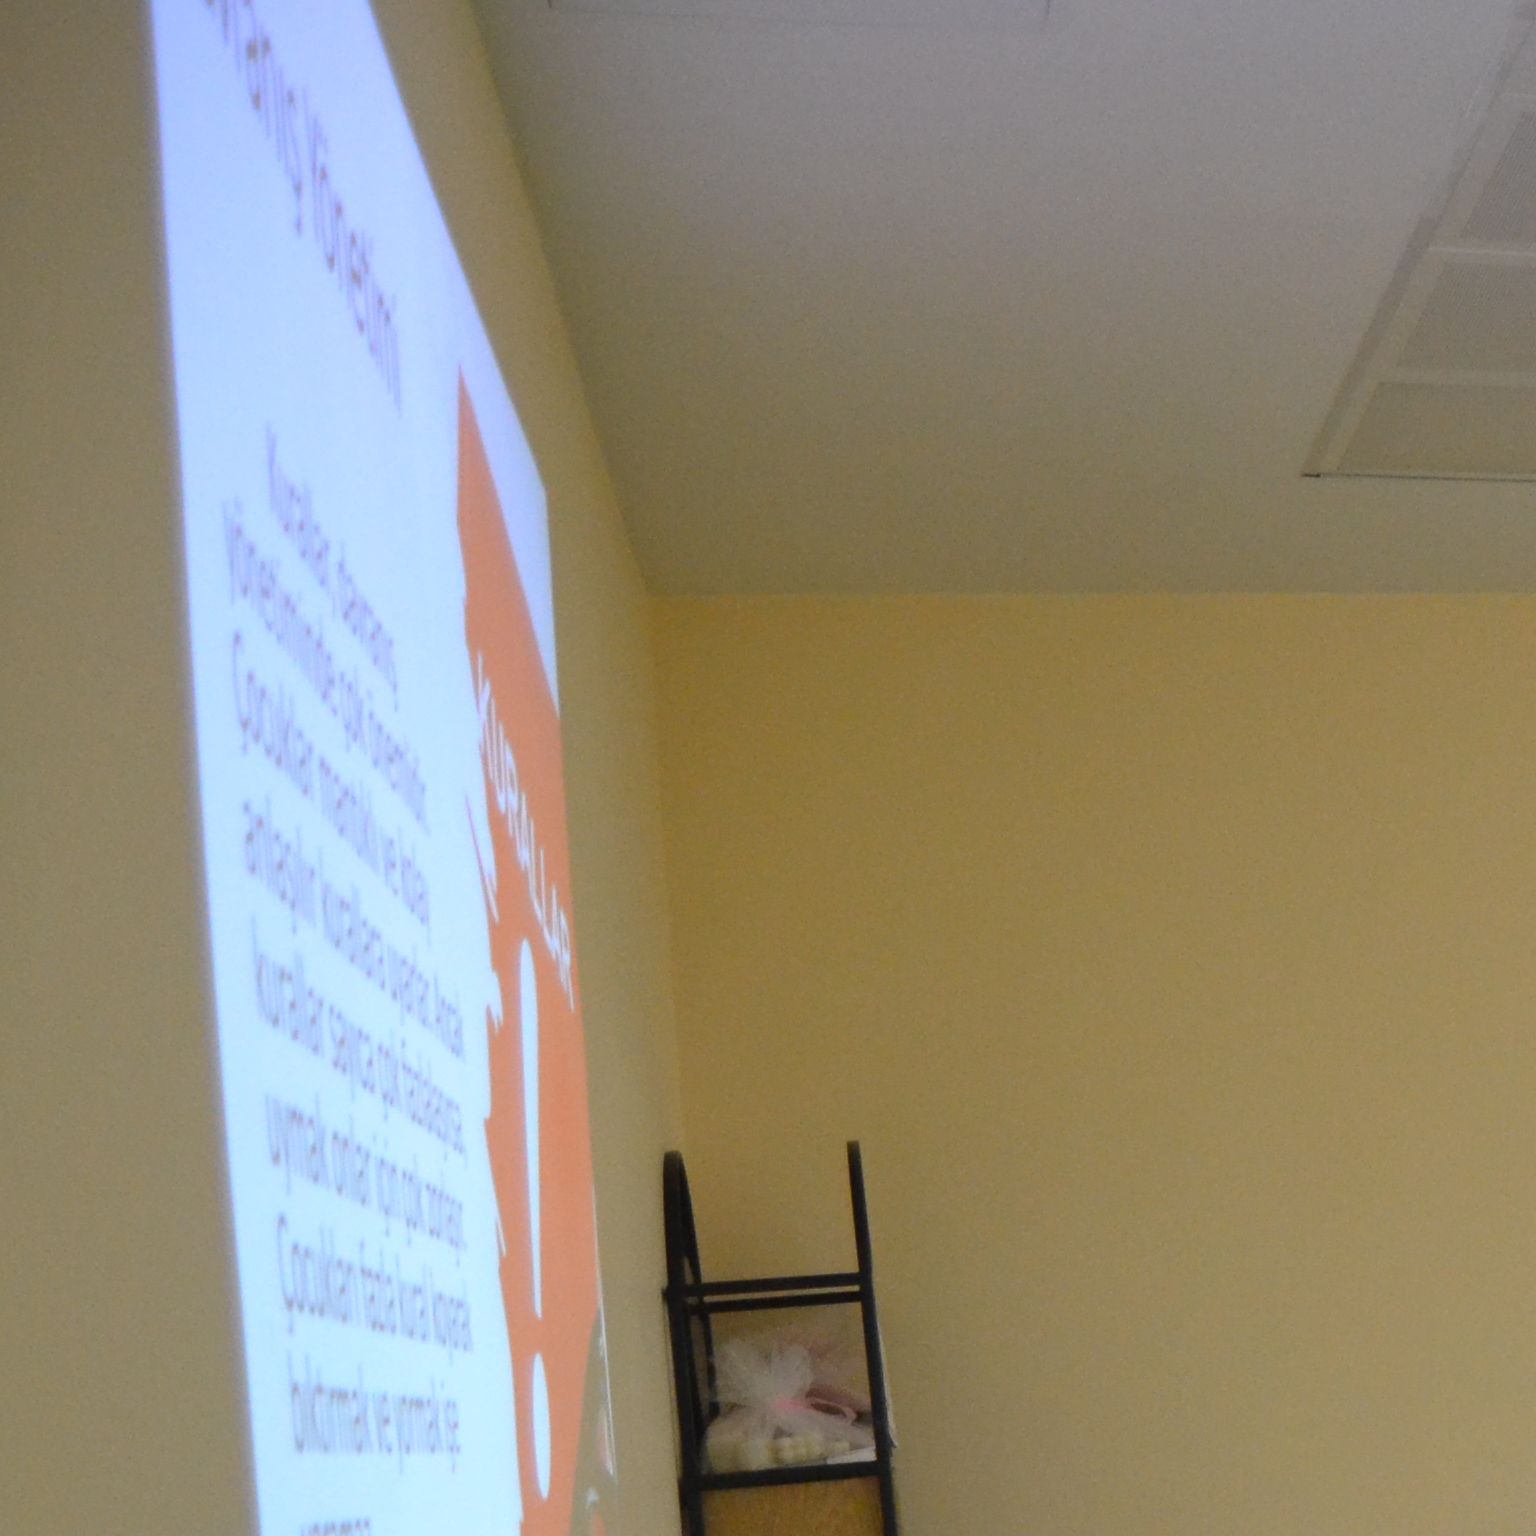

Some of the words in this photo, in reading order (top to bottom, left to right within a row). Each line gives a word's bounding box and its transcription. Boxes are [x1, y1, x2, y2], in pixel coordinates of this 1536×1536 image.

[304, 86, 401, 414] Yönetimi
[223, 499, 339, 717] yönetiminde
[339, 670, 367, 753] çok
[232, 630, 314, 799] Çocuklar
[380, 830, 400, 896] ve
[399, 830, 429, 933] kolay
[476, 649, 574, 1011] KURALLAR
[242, 798, 317, 934] anlaşılır
[319, 857, 387, 991] kurallara
[252, 918, 324, 1056] kurallar
[328, 1004, 376, 1098] sayıca
[376, 1042, 402, 1121] çok
[266, 1096, 331, 1193] uymak
[331, 1121, 371, 1207] onlar
[373, 1136, 403, 1236] için
[401, 1169, 426, 1245] çok
[360, 1241, 397, 1334] fazla
[398, 1277, 432, 1342] kural
[288, 1355, 373, 1454] bıktırmak
[372, 1392, 393, 1455] ve
[392, 1383, 444, 1464] yormak
[442, 1384, 461, 1472] işe
